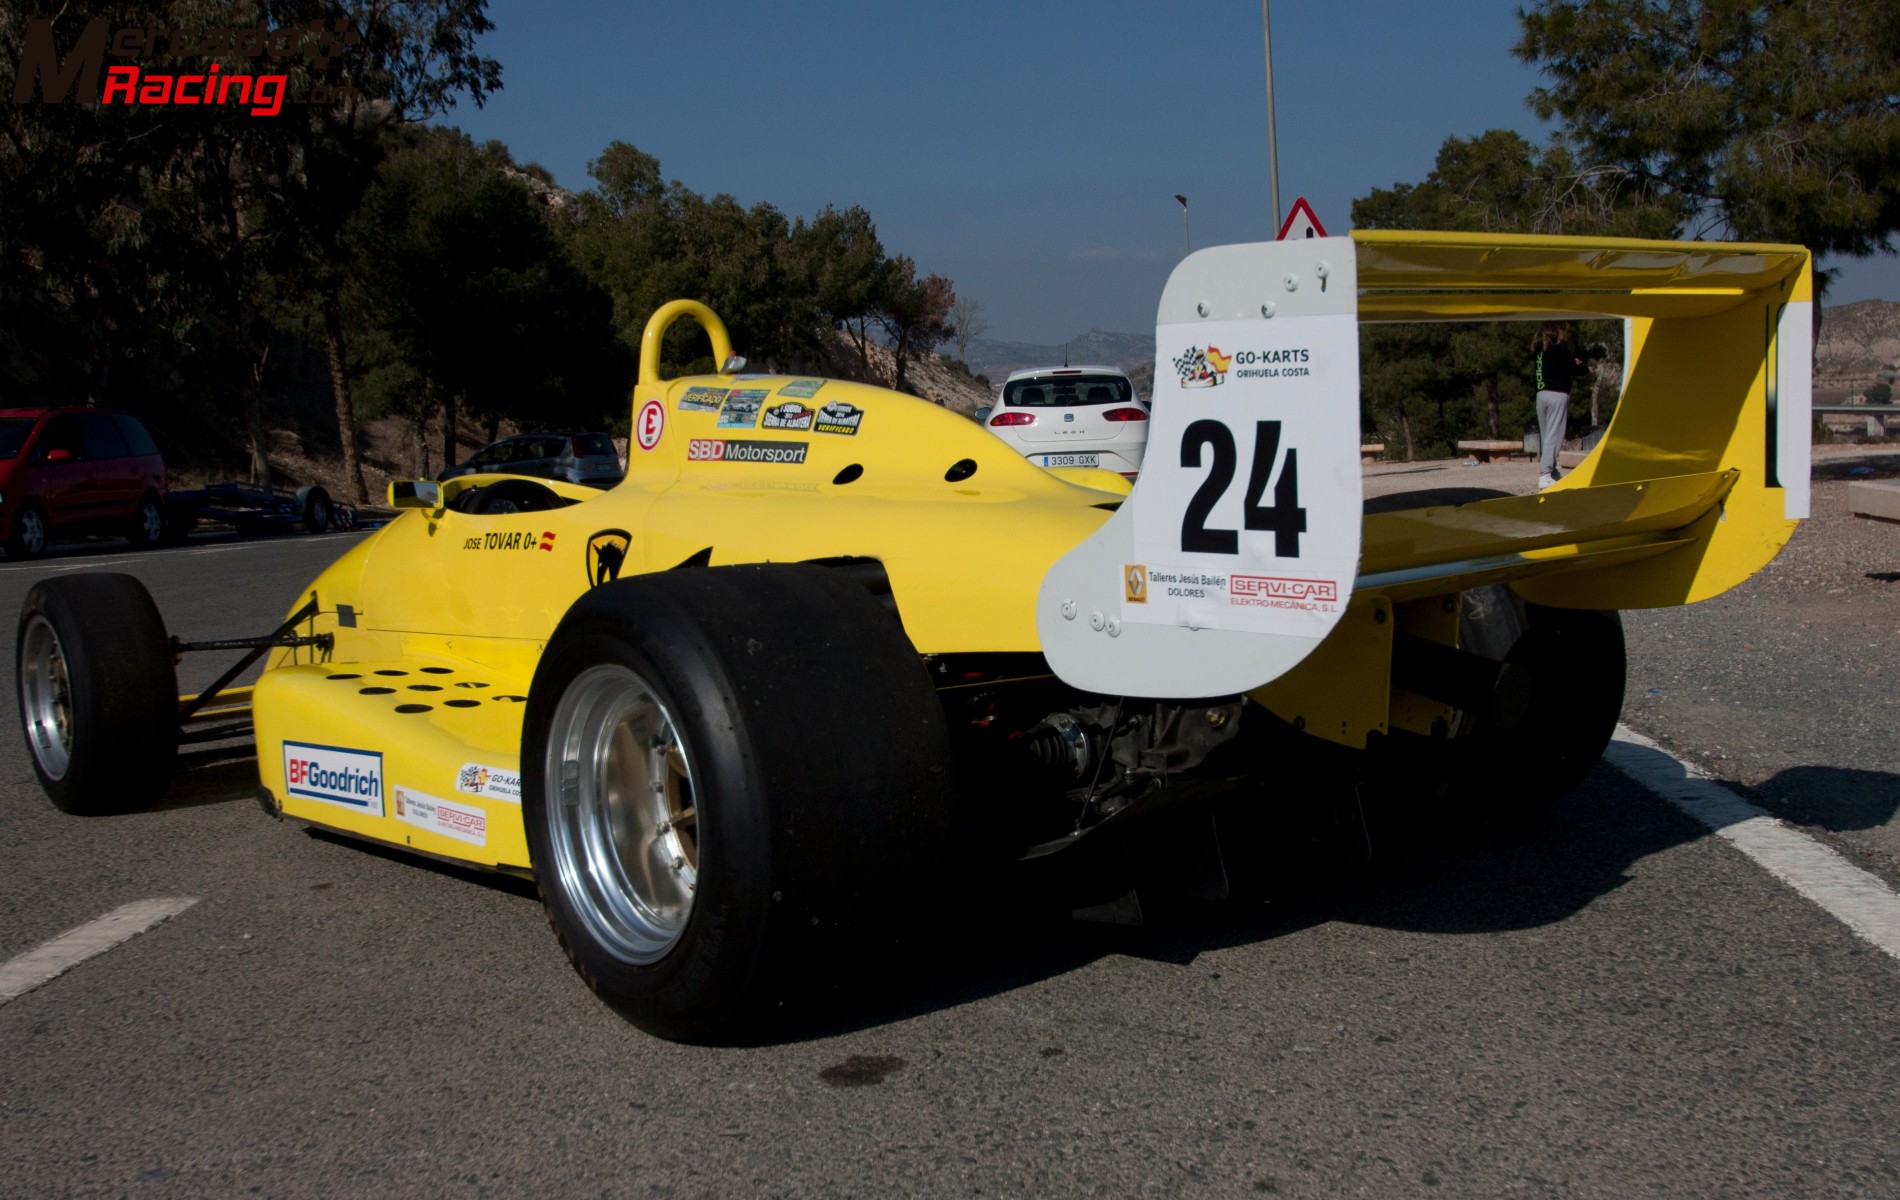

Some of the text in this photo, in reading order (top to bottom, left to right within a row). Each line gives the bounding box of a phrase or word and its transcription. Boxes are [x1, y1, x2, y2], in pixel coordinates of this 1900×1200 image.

[1236, 349, 1309, 364] GO-KARTS
[1237, 368, 1309, 378] ORIHUELA COSTA
[645, 408, 657, 435] E
[818, 424, 854, 434] VERIFICADO
[689, 440, 805, 463] SBD Motorsport
[1051, 455, 1096, 466] 3309 GXK
[1180, 419, 1307, 558] 24
[463, 537, 482, 550] JOSE
[484, 532, 521, 550] TOVAR
[1148, 571, 1226, 586] Talleres Jesús Bailén
[1168, 587, 1205, 598] DOLORES
[1234, 579, 1330, 596] SERVI-CAR
[289, 758, 379, 797] BFGoodrich
[439, 809, 482, 828] SERVI-CAR
